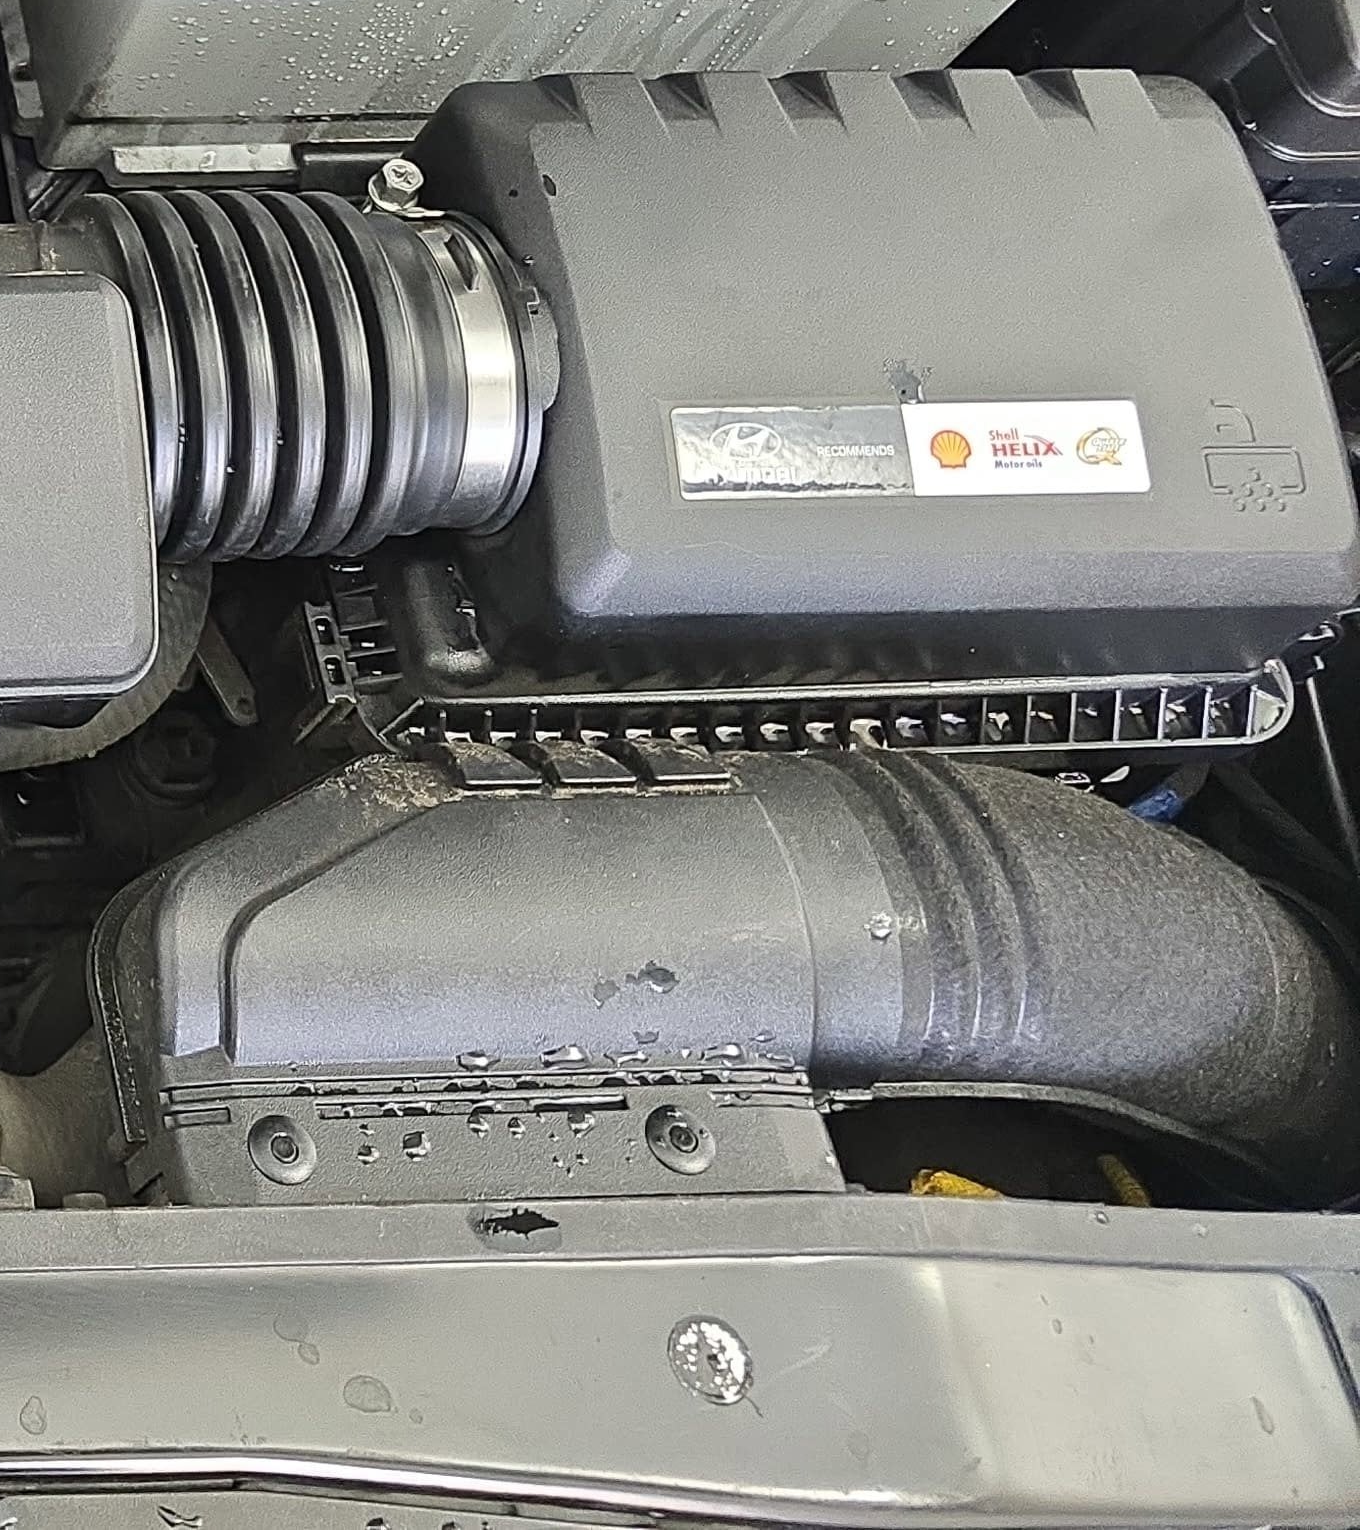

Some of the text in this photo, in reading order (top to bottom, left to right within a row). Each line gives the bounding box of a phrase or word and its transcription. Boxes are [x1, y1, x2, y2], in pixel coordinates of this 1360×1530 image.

[988, 427, 1020, 442] Shell
[816, 444, 896, 458] RECOMMENDS
[991, 441, 1060, 457] HELIX
[994, 458, 1043, 470] Motor oils
